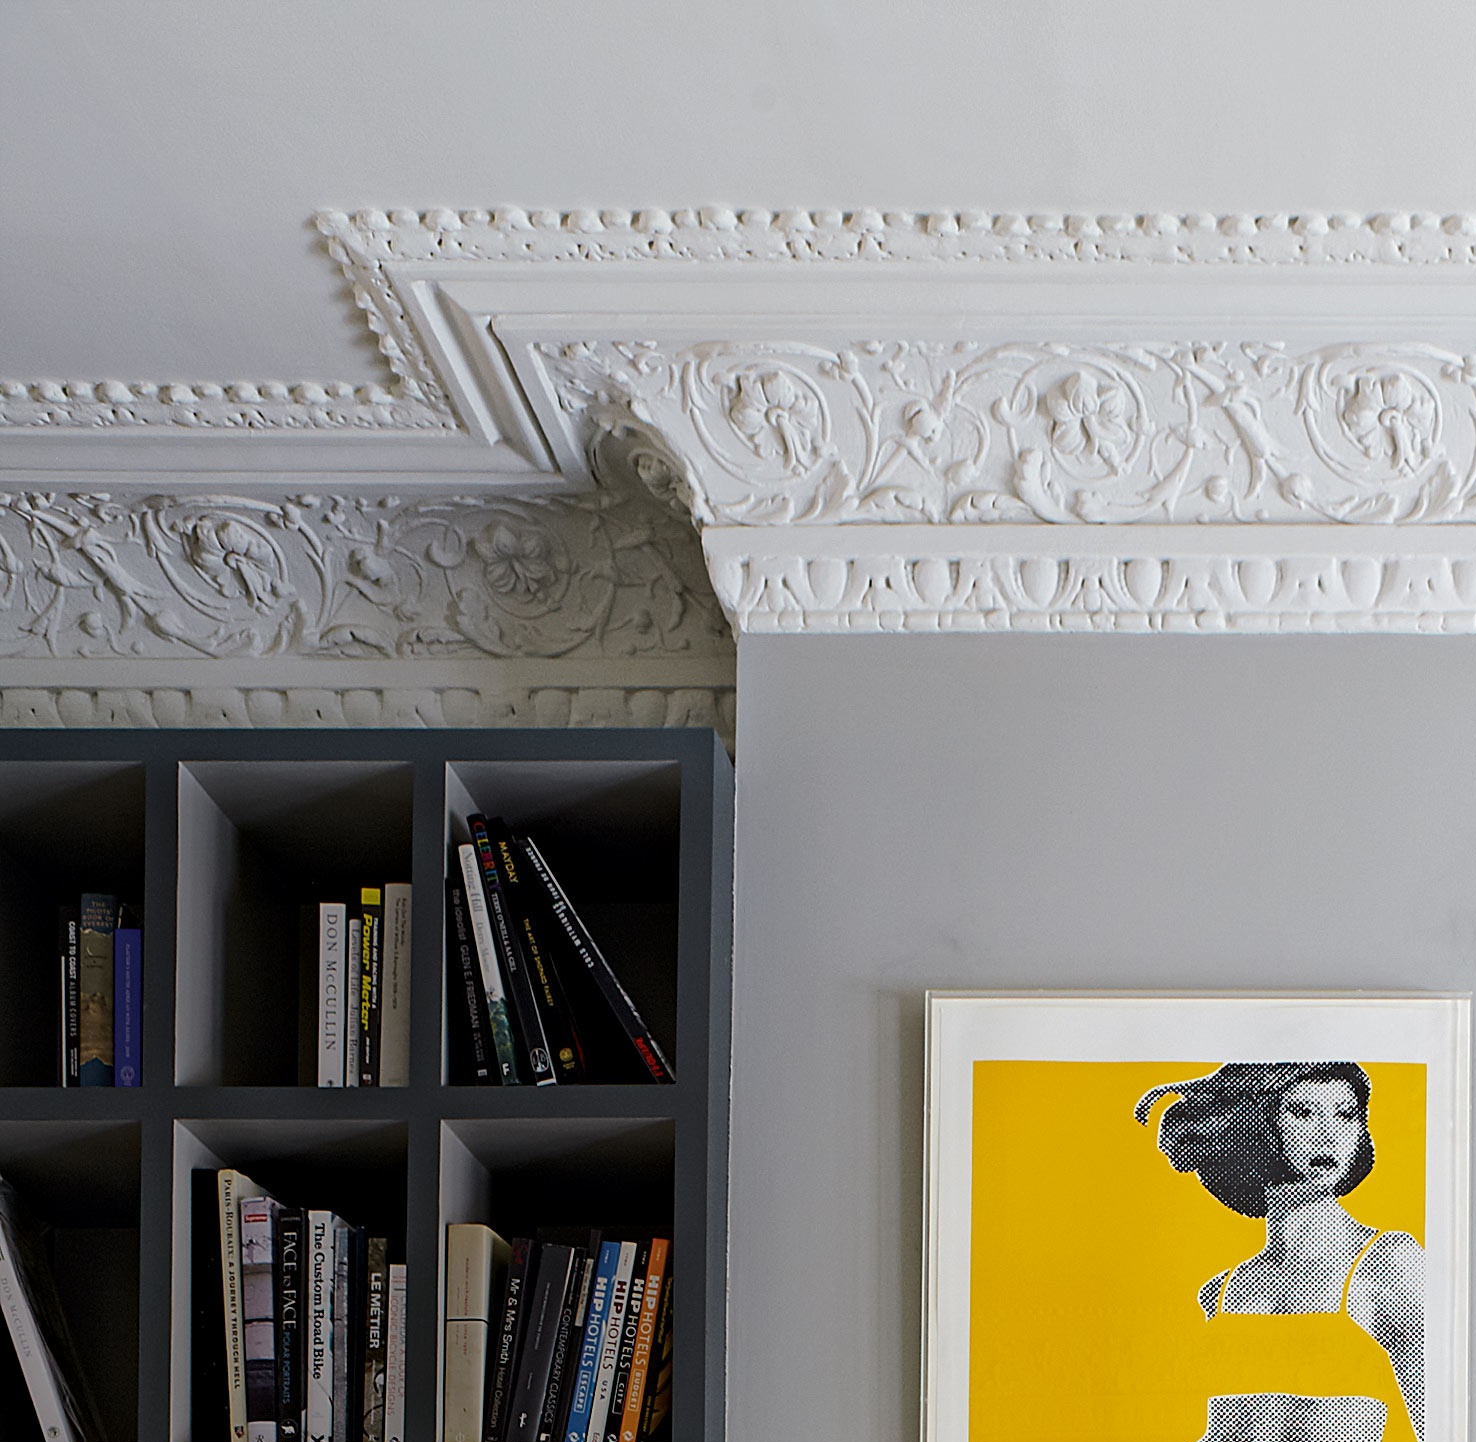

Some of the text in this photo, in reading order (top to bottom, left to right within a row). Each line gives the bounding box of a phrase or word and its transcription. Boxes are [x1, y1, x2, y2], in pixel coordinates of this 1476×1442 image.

[473, 821, 499, 890] CELEBRITY
[498, 841, 519, 883] MAYDAY
[363, 913, 373, 970] Power
[68, 921, 77, 1037] COAST TO COAST ALBUM COVERS
[326, 914, 337, 1050] DON McCULLIN
[361, 975, 371, 1031] Meter
[282, 1232, 297, 1272] FACE
[228, 1270, 236, 1313] JOURNEY
[282, 1290, 296, 1330] FACE
[312, 1223, 325, 1379] The Custom Road Bike
[369, 1272, 384, 1349] LE MÉTIER
[614, 1281, 627, 1314] HIP
[231, 1317, 240, 1363] THROUGH
[282, 1331, 291, 1358] POLAR
[576, 1277, 608, 1410] HIP HOTELS ESCAPE
[603, 1317, 621, 1370] HOTELS
[616, 1278, 645, 1404] HIP HOTELS CITY
[629, 1275, 660, 1409] HIP HOTELS BUDGET
[281, 1360, 291, 1403] PORTRAITS
